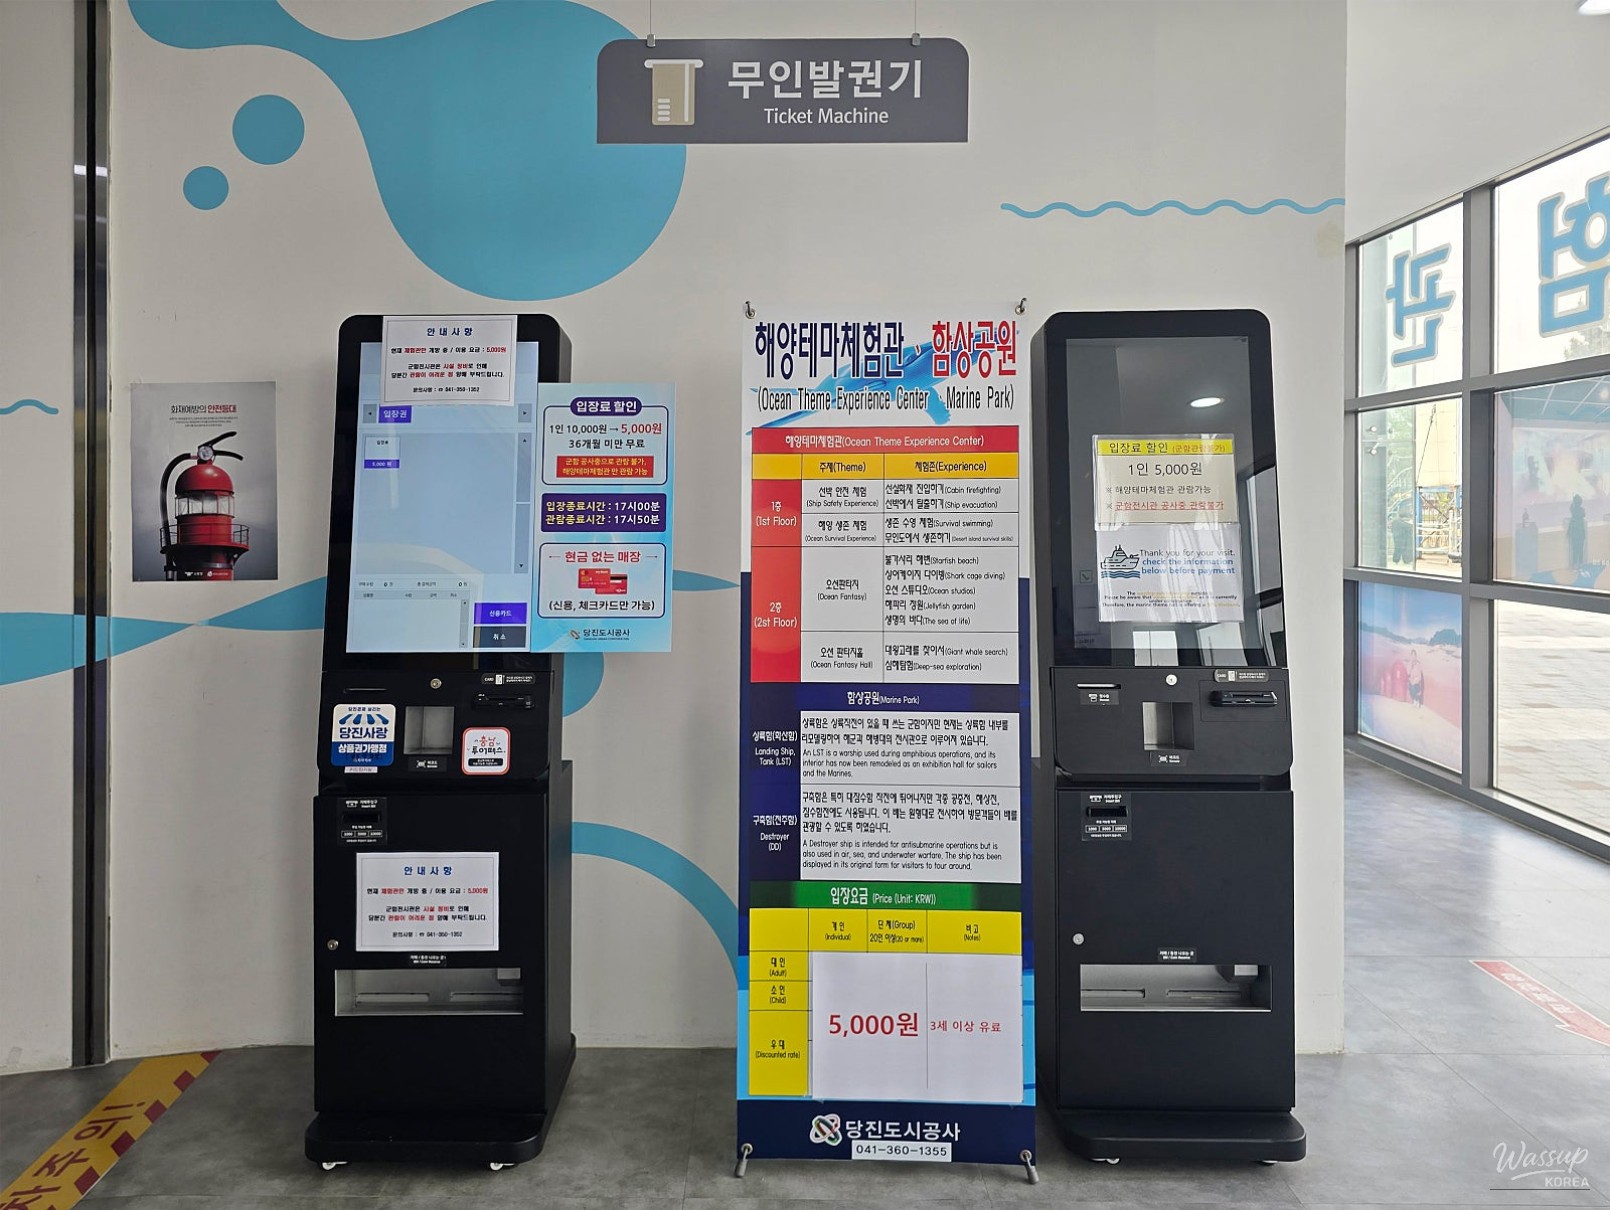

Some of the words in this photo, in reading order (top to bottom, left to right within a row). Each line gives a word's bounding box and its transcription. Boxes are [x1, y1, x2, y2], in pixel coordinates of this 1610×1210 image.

[727, 60, 922, 99] 무인발권기
[763, 107, 813, 125] Ticket
[818, 106, 889, 125] Machine
[755, 321, 905, 380] 해양테마체험관
[932, 320, 1018, 379] 함상공원
[757, 386, 793, 412] (Ocean
[797, 387, 831, 410] Theme
[837, 386, 891, 415] Experience
[896, 385, 929, 410] Center
[946, 386, 981, 409] Marine
[987, 383, 1014, 410] Park)
[170, 405, 206, 414] 화재예방의
[207, 404, 237, 413] 안전등대
[576, 401, 611, 413] 입장료
[614, 401, 637, 412] 할인
[383, 410, 407, 418] 입장권
[550, 424, 564, 434] 1인
[567, 424, 607, 435] 10,000원
[621, 423, 662, 435] 5,000원
[569, 439, 601, 449] 36개월
[604, 439, 623, 449] 미만
[626, 439, 645, 449] 무료
[874, 436, 902, 447] Theme
[904, 436, 950, 448] Experience
[952, 435, 984, 447] Center)
[1109, 442, 1142, 454] 입장료
[1146, 442, 1168, 454] 할인
[1128, 462, 1149, 476] 1인
[1154, 462, 1202, 477] 5,000원
[819, 487, 833, 498] 선박
[835, 487, 849, 498] 안전
[852, 486, 867, 498] 체험
[1115, 485, 1174, 494] 해양테마체험관
[1178, 485, 1211, 494] 관람가능
[546, 501, 606, 512] 입장종료시간
[615, 501, 660, 512] 17시00분
[771, 501, 782, 512] 1층
[806, 500, 822, 508] (Ship
[823, 499, 842, 508] Safety
[844, 499, 879, 508] Experience)
[1114, 501, 1158, 511] 군함전시관
[1161, 501, 1187, 510] 공사중
[546, 515, 606, 525] 관람종료시간
[614, 515, 660, 525] 17시50분
[756, 516, 771, 527] (1st
[773, 515, 797, 527] Floor)
[818, 520, 833, 532] 해양
[835, 520, 850, 532] 생존
[852, 520, 867, 531] 체험
[565, 551, 589, 563] 현금
[591, 551, 615, 563] 없는
[618, 551, 641, 563] 매장
[1140, 549, 1164, 557] Thank
[1165, 550, 1180, 558] you
[1182, 549, 1194, 557] for
[1195, 550, 1214, 558] your
[1142, 558, 1167, 566] check
[1168, 558, 1182, 566] the
[1184, 558, 1234, 566] information
[1198, 567, 1235, 576] payment
[826, 579, 859, 590] 오션판타지
[549, 600, 576, 611] (신용,
[578, 600, 629, 611] 체크카드만
[631, 600, 655, 611] 가능)
[769, 601, 782, 614] 2층
[489, 609, 512, 617] 신용카드
[754, 616, 771, 628] (2st
[773, 617, 798, 628] Floor)
[583, 629, 630, 637] 당진도시공사
[339, 727, 388, 739] 당진사랑
[338, 743, 387, 754] 상품권가맹점
[816, 769, 826, 777] the
[760, 832, 790, 841] Destroyer
[830, 887, 868, 905] 입장요금
[828, 1012, 919, 1038] 5,000원
[929, 1020, 948, 1032] 3세
[952, 1020, 975, 1033] 이상
[979, 1021, 1002, 1033] 유료
[845, 1120, 961, 1141] 당진도시공사
[855, 1144, 947, 1157] 041-360-1355
